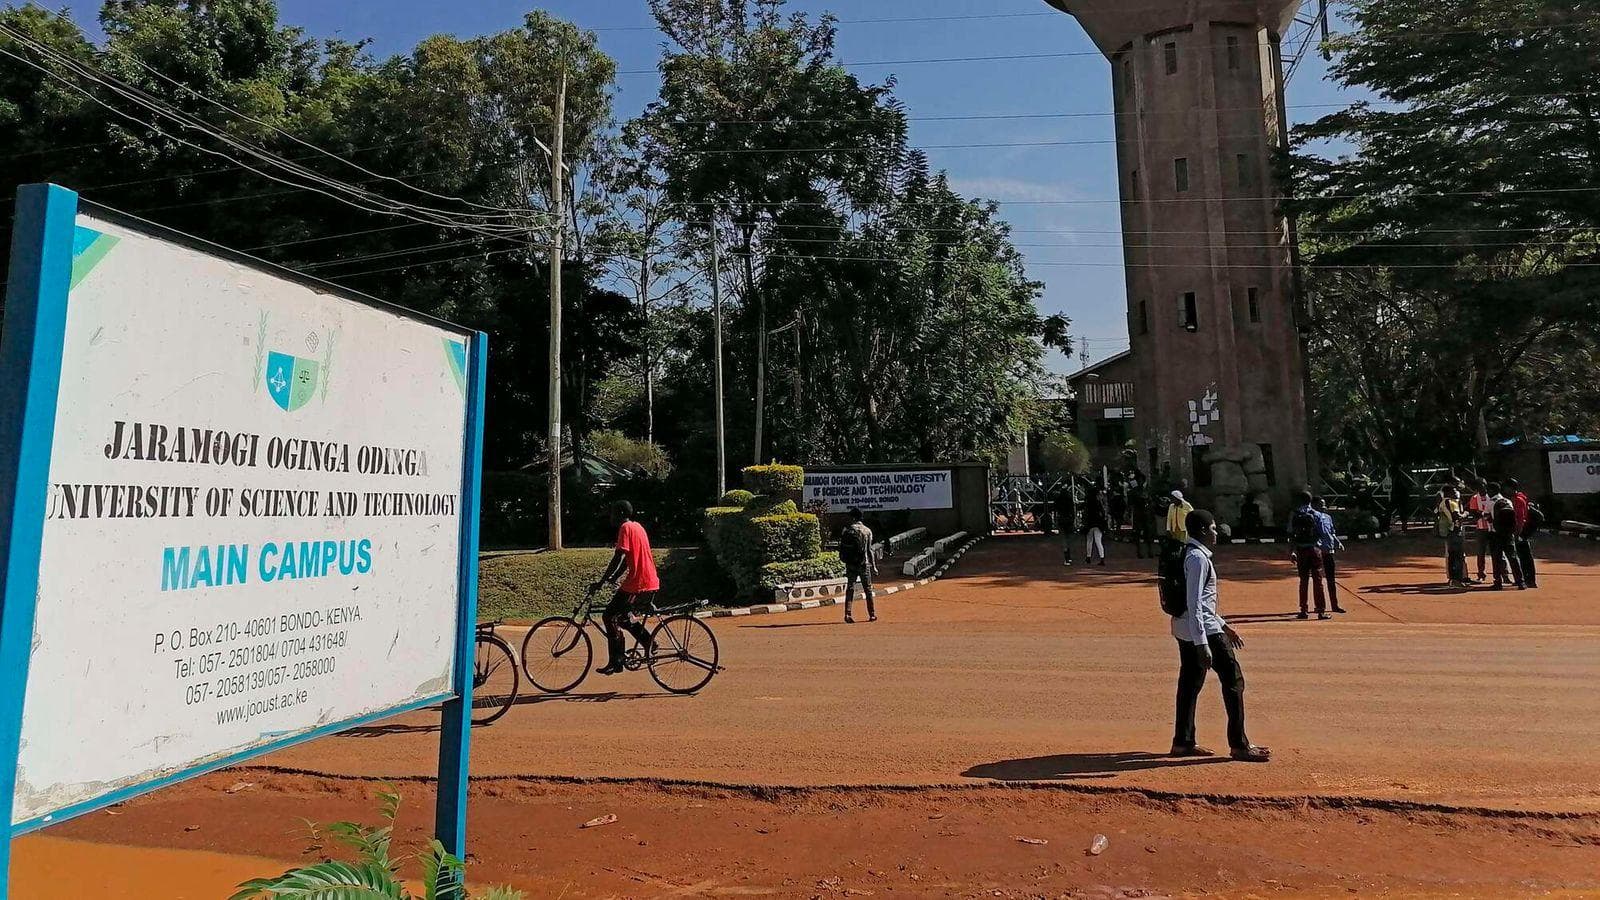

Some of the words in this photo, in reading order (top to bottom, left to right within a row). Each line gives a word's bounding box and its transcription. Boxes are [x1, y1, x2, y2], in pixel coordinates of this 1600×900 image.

[104, 421, 260, 467] JARAMOGI
[267, 436, 350, 473] OGINGA
[357, 445, 429, 477] ODINGA
[205, 487, 234, 518] OF
[239, 488, 319, 518] SCIENCE
[323, 491, 358, 517] AND
[363, 492, 457, 516] TECHNOLOGY
[821, 486, 850, 497] SCIENCE
[851, 486, 868, 496] AND
[868, 484, 926, 496] TECHNOLOGY
[831, 475, 859, 486] OGINGA
[861, 474, 891, 485] ODINGA
[894, 473, 947, 483] UNIVERSITY
[161, 543, 249, 591] MAIN
[259, 538, 372, 583] CAMPUS
[153, 632, 165, 654] P.
[170, 630, 185, 651] O.
[189, 628, 213, 648] Box
[216, 624, 241, 644] 210-
[244, 616, 277, 639] 40601
[280, 610, 324, 633] BONDO-
[326, 605, 363, 625] KENYA.
[174, 659, 195, 679] Tel:
[199, 653, 225, 674] 057-
[228, 644, 280, 668] 2501804/
[281, 638, 307, 658] 0704
[308, 631, 348, 652] 431648/
[186, 685, 213, 706] 057-
[293, 656, 336, 682] 2058000
[217, 688, 308, 725] www.jooust.ac.ke
